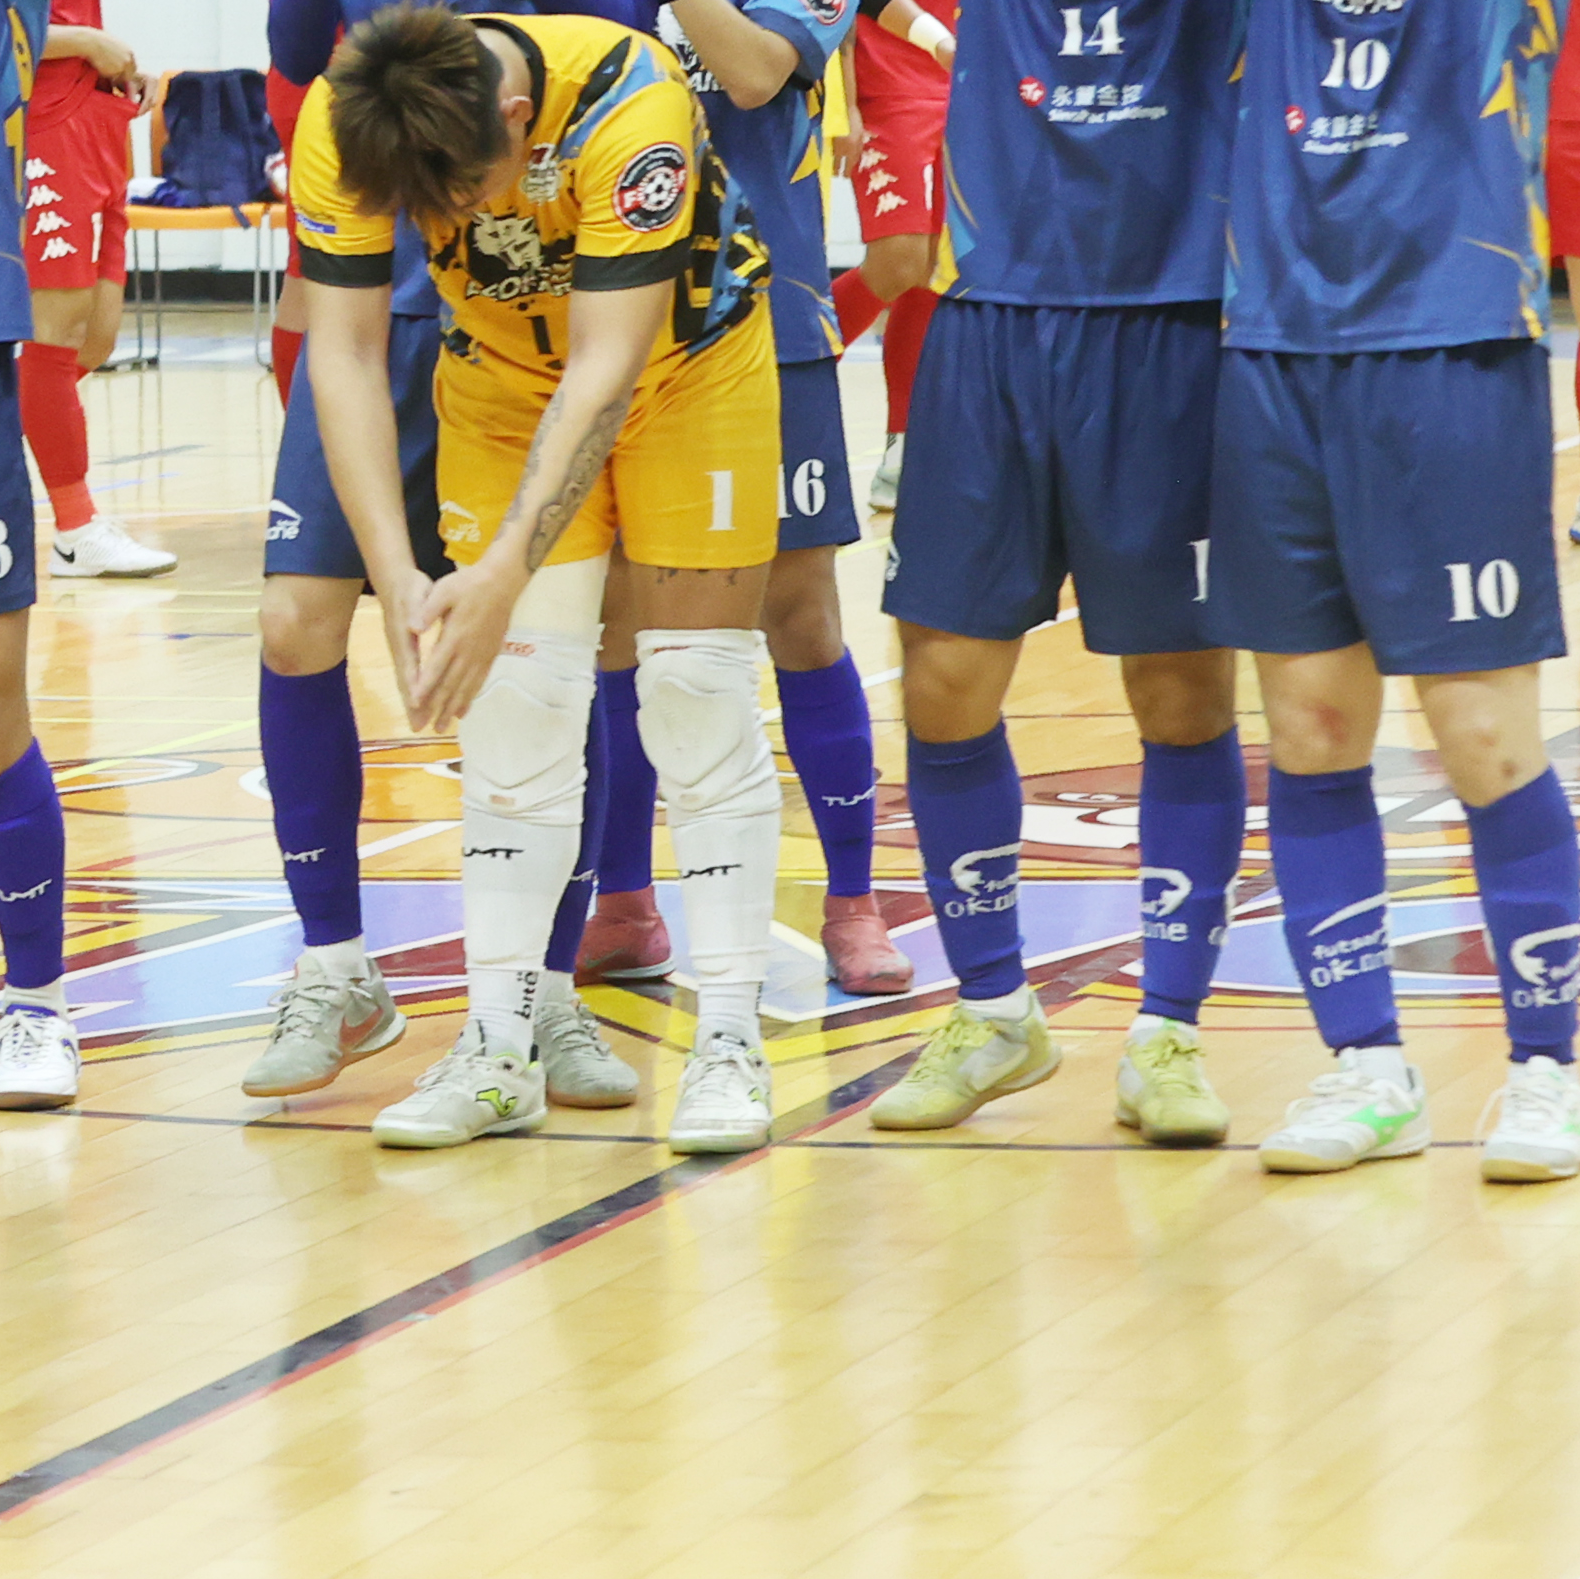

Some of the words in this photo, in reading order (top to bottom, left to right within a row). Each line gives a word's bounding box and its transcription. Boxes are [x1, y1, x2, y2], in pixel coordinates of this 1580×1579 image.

[1058, 6, 1126, 56] 14
[1321, 38, 1391, 91] 10
[705, 470, 735, 531] 1
[778, 458, 826, 519] 16
[1444, 558, 1518, 623] 10
